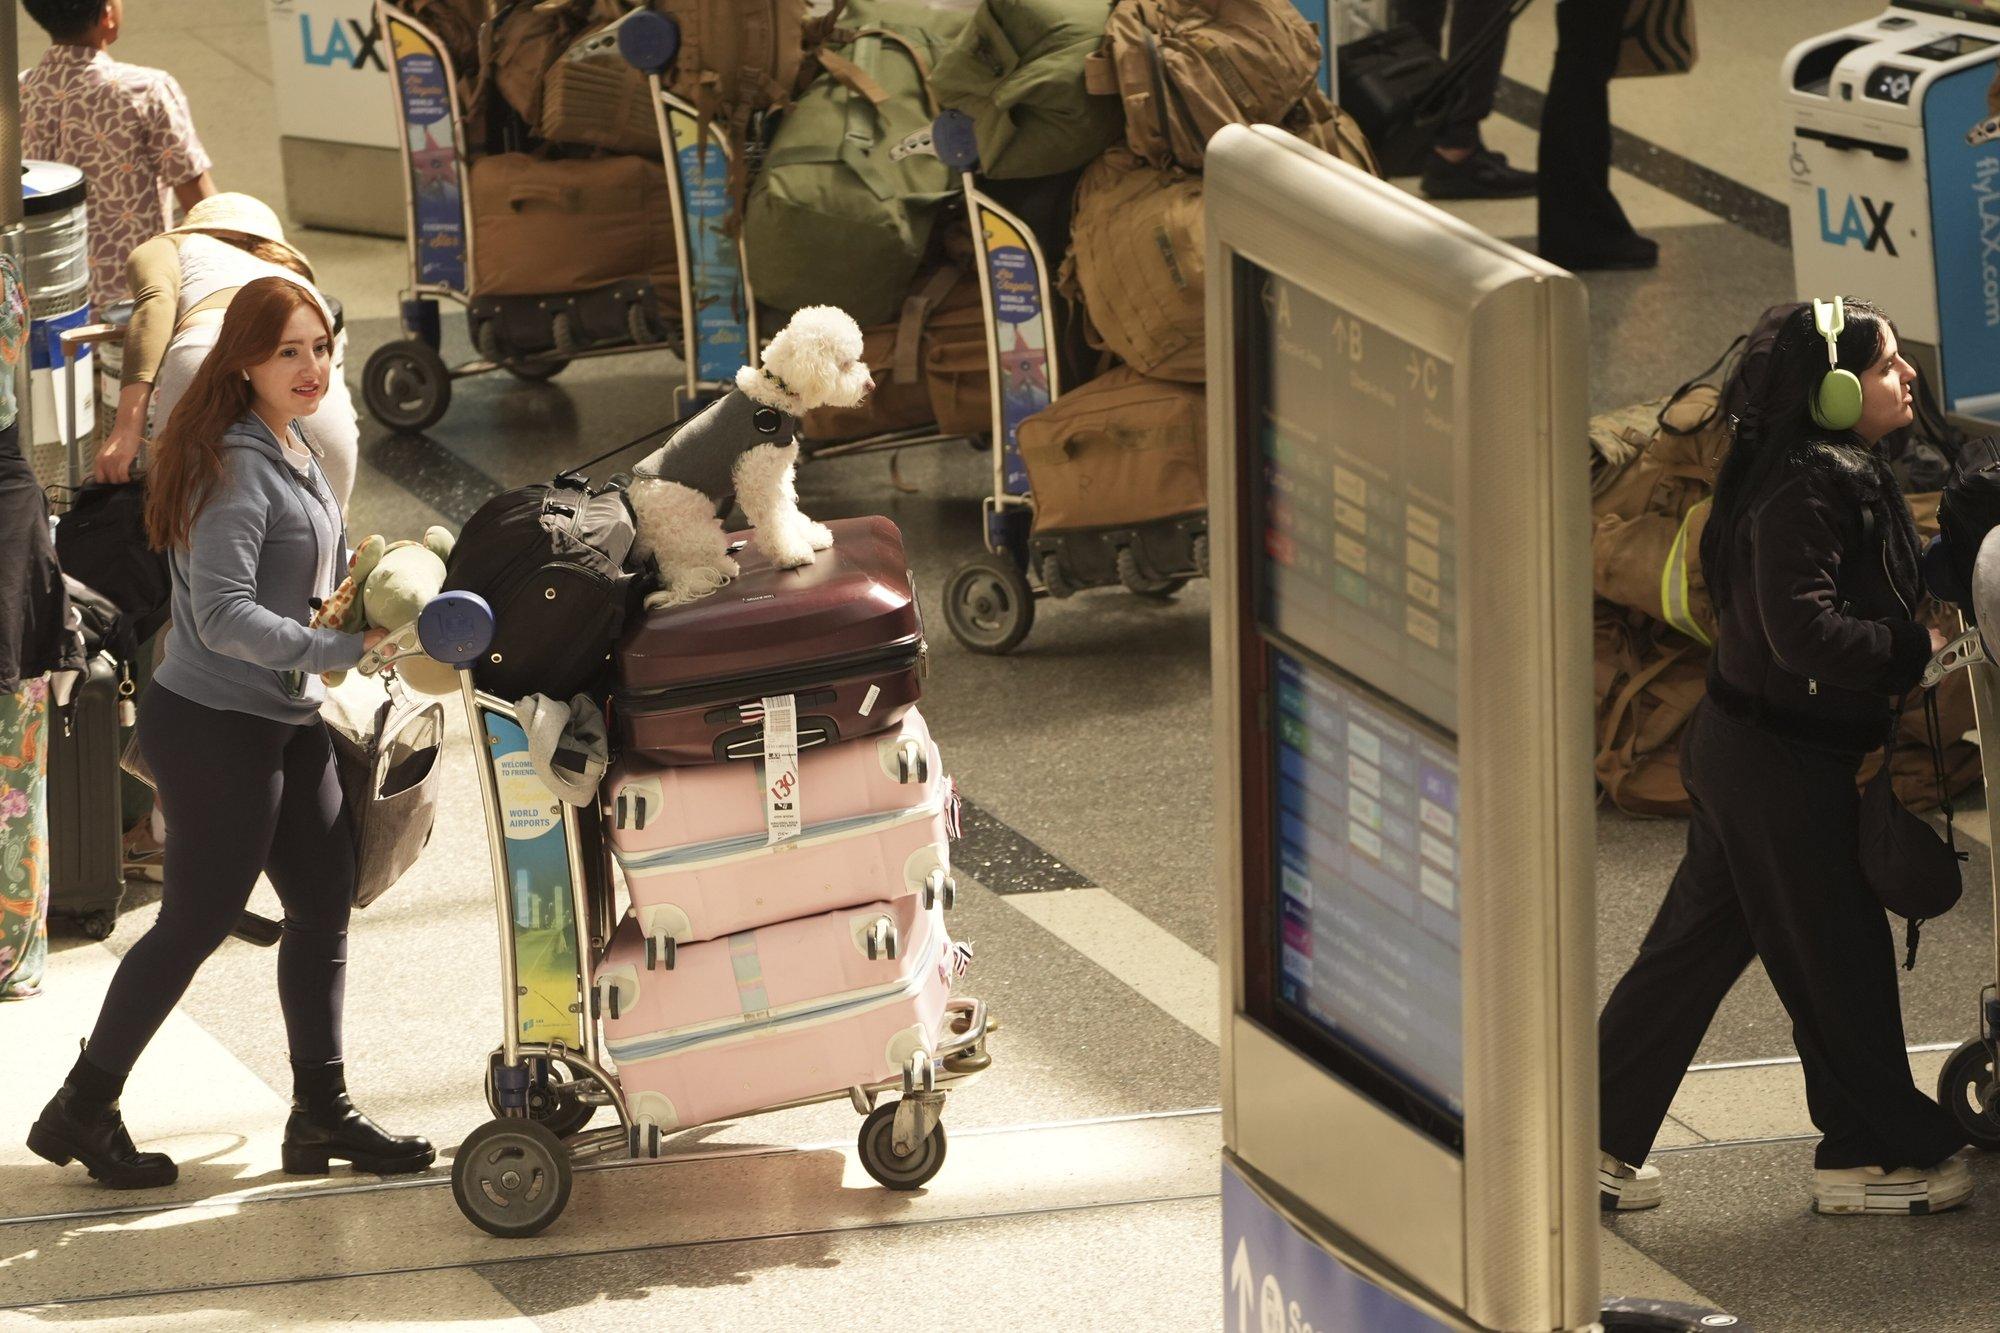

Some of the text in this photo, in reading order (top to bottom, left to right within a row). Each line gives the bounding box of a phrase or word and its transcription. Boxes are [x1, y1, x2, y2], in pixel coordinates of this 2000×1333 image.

[300, 14, 388, 72] LAX
[1817, 187, 1900, 257] LAX
[1972, 156, 2000, 327] flyLAX.com
[1349, 319, 1364, 363] B
[1424, 357, 1438, 400] C
[502, 769, 537, 777] TO FRIEND
[770, 770, 797, 801] 130
[509, 809, 539, 818] WORLD
[509, 819, 550, 828] AIRPORTS
